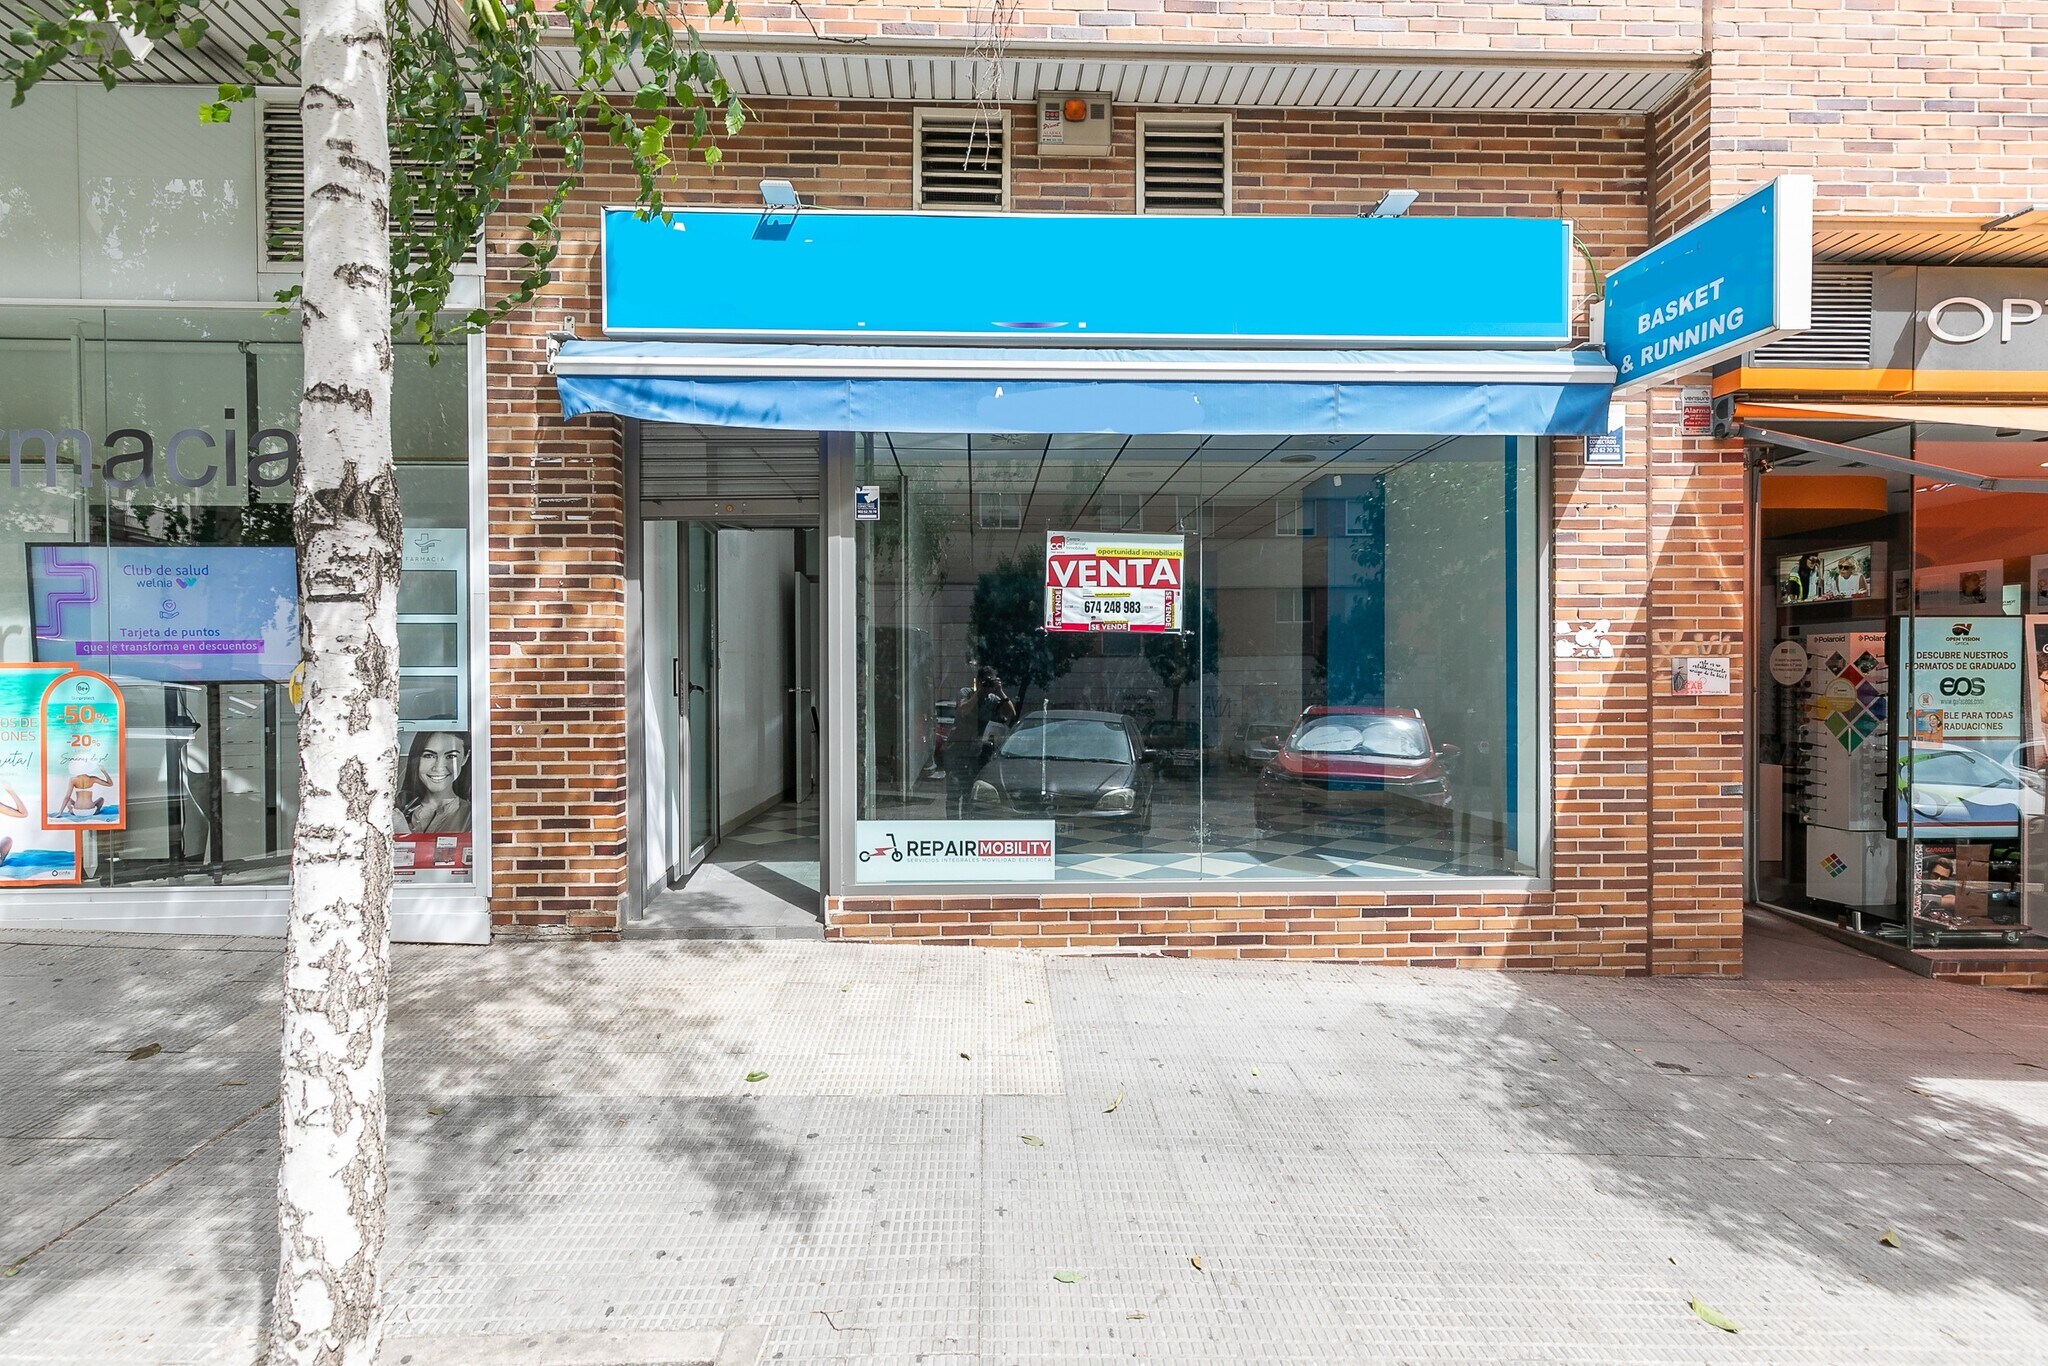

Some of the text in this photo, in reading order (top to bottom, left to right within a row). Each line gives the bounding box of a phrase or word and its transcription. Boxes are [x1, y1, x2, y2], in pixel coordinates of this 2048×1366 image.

[1638, 276, 1725, 334] BASKET
[1927, 296, 2048, 342] OP
[1620, 306, 1744, 374] & RUNNING
[0, 407, 301, 488] macia
[1097, 548, 1183, 558] oportunidad inmobiliaria
[123, 564, 209, 576] Club de salud
[1050, 558, 1179, 588] VENTA
[136, 578, 173, 588] welnia
[1165, 590, 1172, 601] SE
[1084, 600, 1141, 614] 674 248 983
[1055, 616, 1062, 627] SE
[120, 628, 221, 639] Tarjeta de puntos
[1818, 635, 1846, 643] Polaroid
[83, 645, 104, 654] que
[120, 642, 179, 652] transforma
[182, 643, 196, 652] en
[198, 641, 258, 652] descuentos
[1916, 651, 2009, 660] DESCUBRE NUESTROS
[1956, 662, 1968, 670] DE
[1969, 662, 2017, 670] GRADUADO
[57, 704, 109, 723] -50%
[1961, 712, 1983, 720] PARA
[1985, 712, 2014, 720] TODAS
[20, 717, 38, 728] DE
[66, 734, 101, 747] -20%
